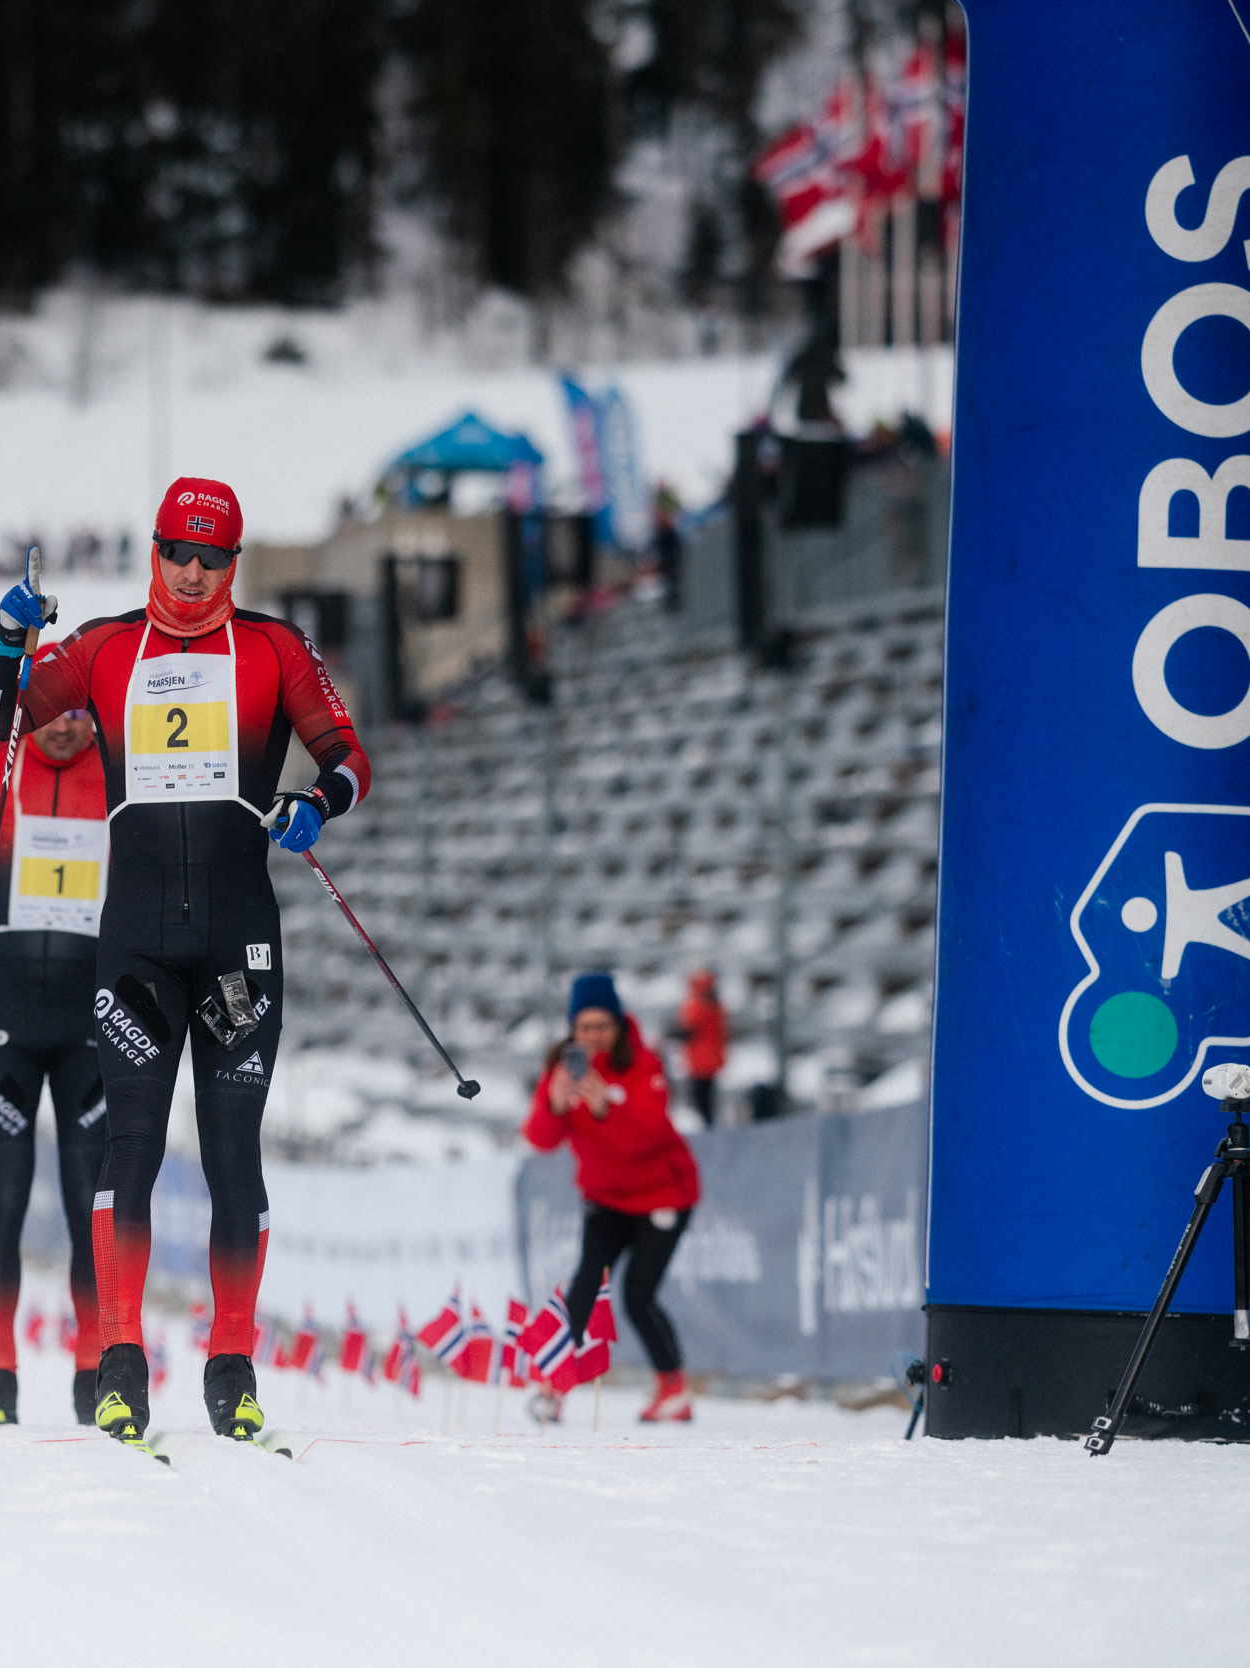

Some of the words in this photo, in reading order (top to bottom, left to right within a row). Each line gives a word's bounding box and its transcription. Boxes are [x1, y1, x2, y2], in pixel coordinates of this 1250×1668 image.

[1132, 154, 1250, 750] OBOS
[196, 500, 229, 516] CHARGE
[197, 493, 229, 510] RAGDE
[147, 676, 185, 688] MARSJEN
[317, 666, 344, 718] CHARGE
[167, 708, 189, 748] 2
[53, 864, 65, 894] 1
[101, 1022, 146, 1067] CHARGE
[109, 1008, 160, 1060] RAGDE
